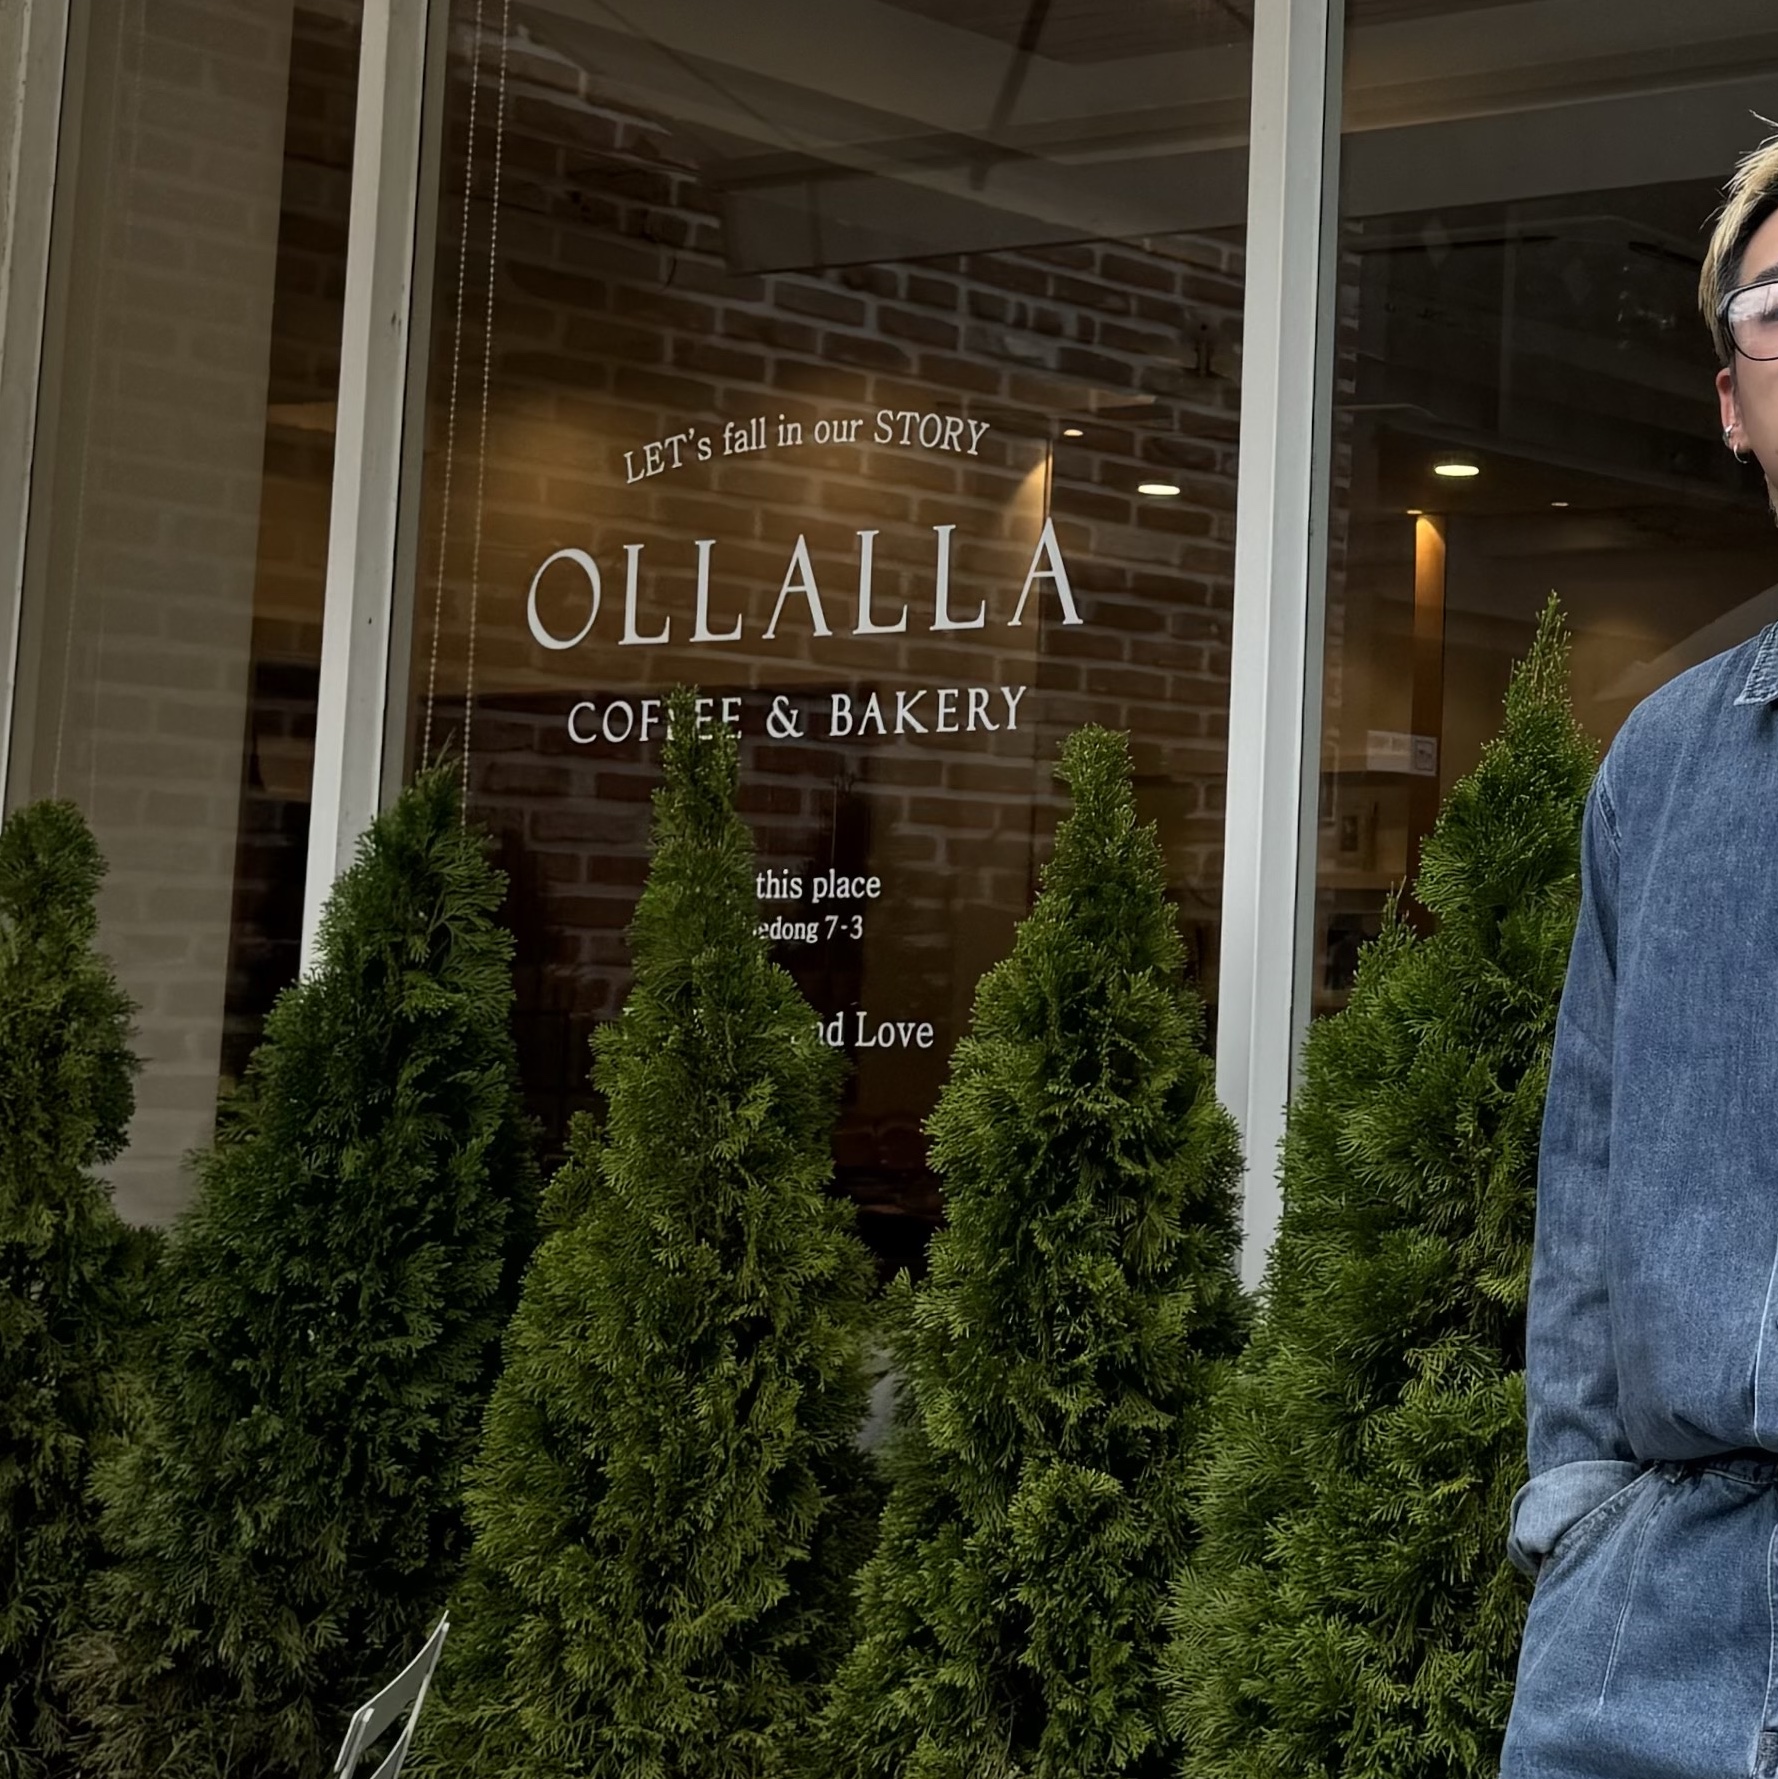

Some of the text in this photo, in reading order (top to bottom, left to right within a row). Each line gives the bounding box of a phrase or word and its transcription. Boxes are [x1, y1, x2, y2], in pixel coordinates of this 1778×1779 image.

[624, 408, 991, 485] LET's fall in our STORY
[526, 516, 1084, 651] OLLALLA
[765, 694, 805, 740] &
[828, 685, 1027, 738] BAKERY
[756, 868, 882, 905] this place
[753, 914, 864, 944] edong 7-3
[854, 1010, 935, 1049] Love
